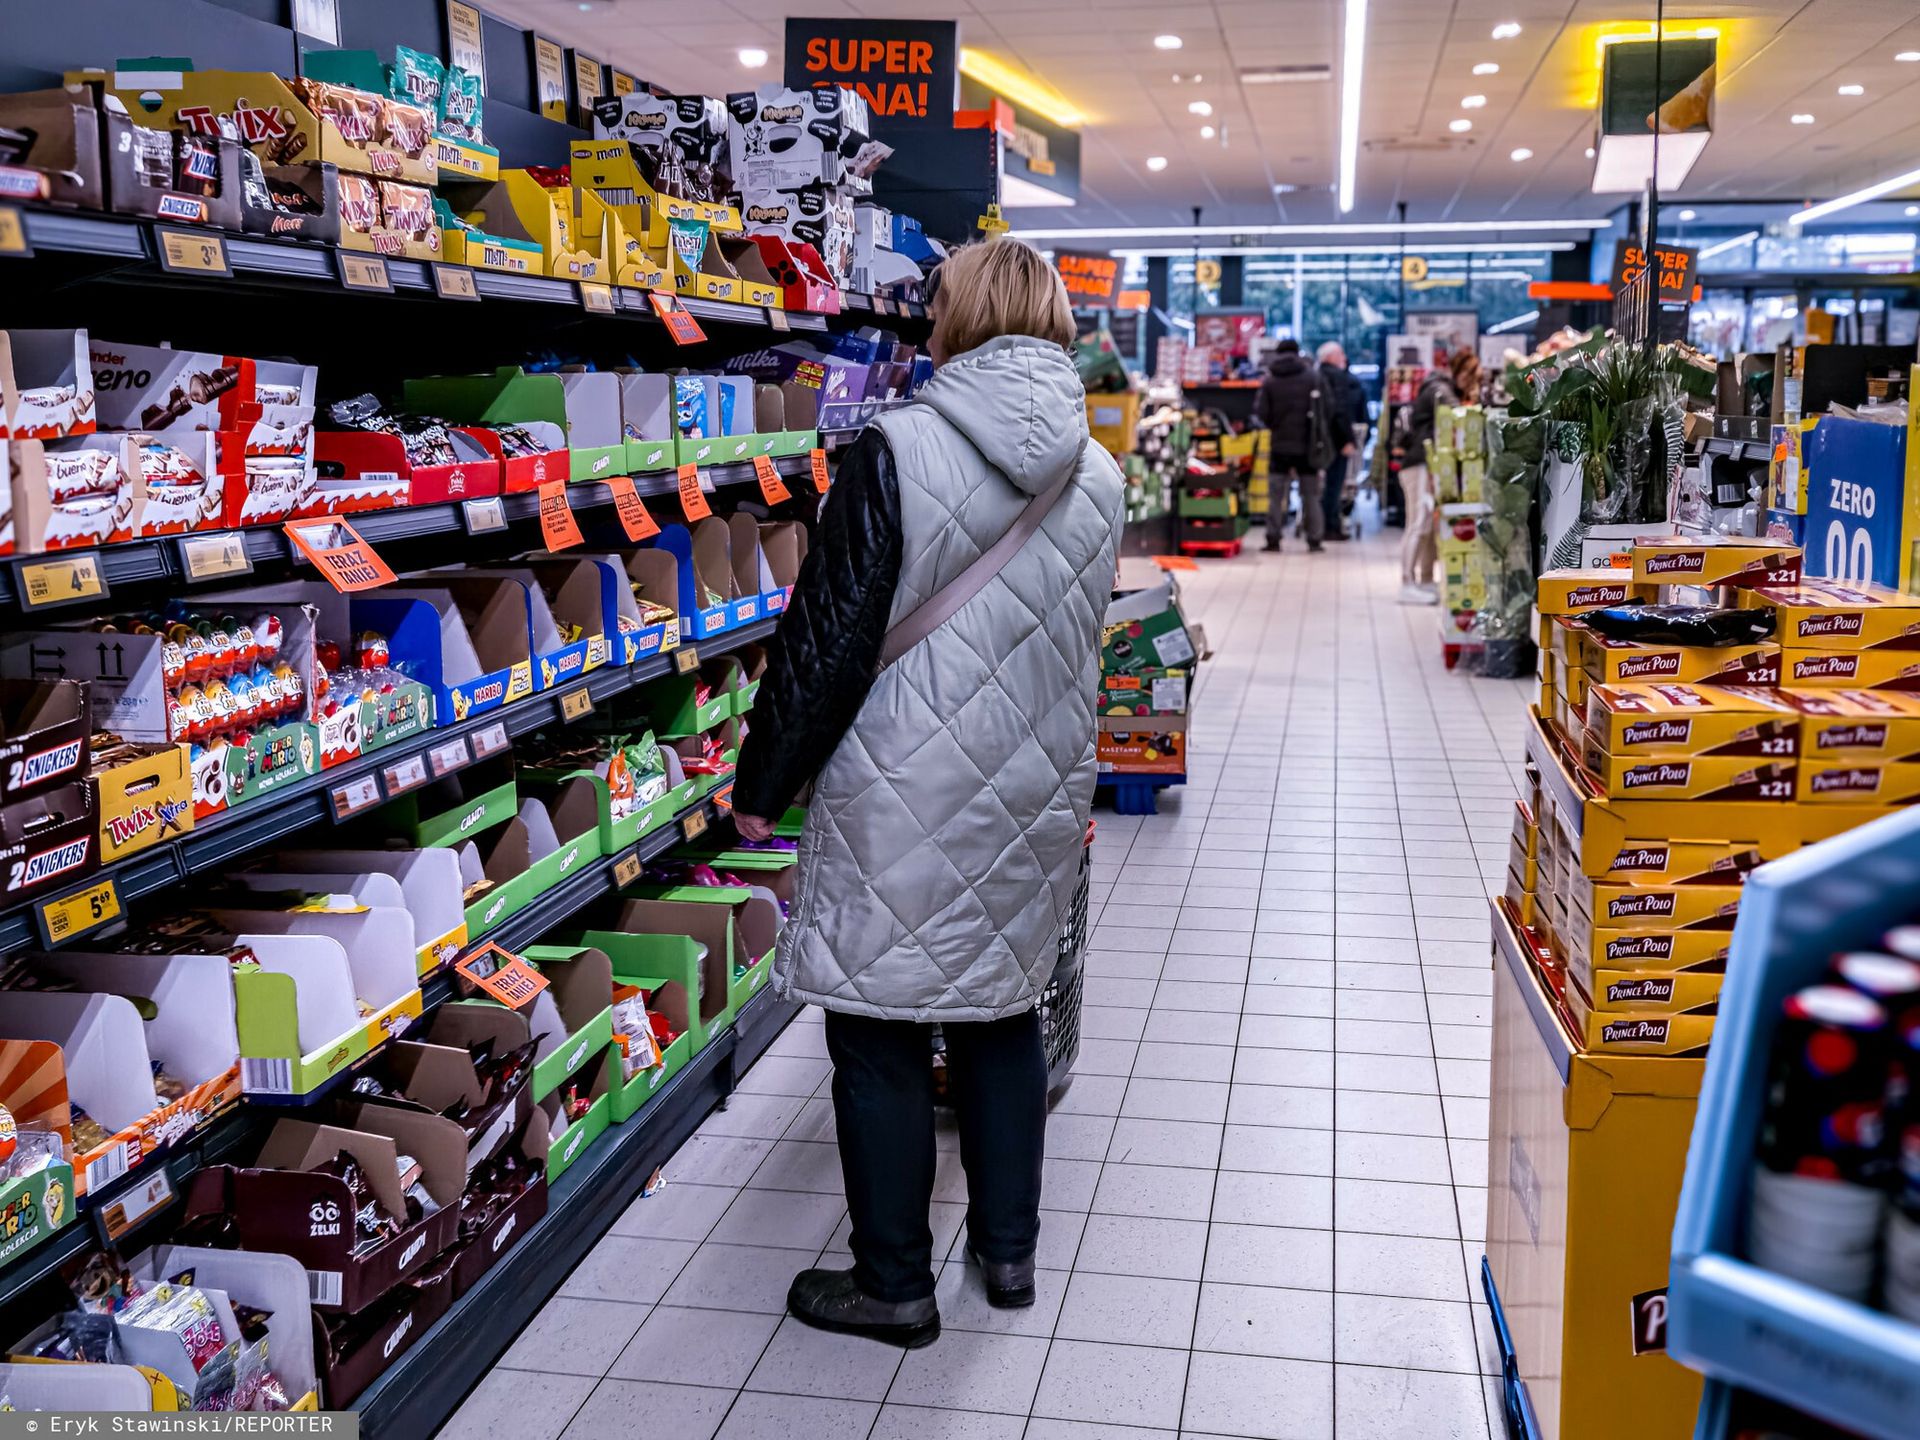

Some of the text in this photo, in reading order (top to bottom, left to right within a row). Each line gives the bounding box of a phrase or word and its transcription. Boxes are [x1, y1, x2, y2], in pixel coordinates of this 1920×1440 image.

[806, 38, 933, 75] SUPER
[812, 81, 929, 118] NA!
[162, 197, 200, 218] SNICKERS
[271, 215, 304, 233] Mars
[727, 349, 781, 369] Milka
[93, 368, 152, 393] eno
[56, 463, 87, 481] bueno
[261, 481, 284, 494] bueno
[1829, 478, 1876, 519] ZERO
[324, 549, 369, 572] TERAZ
[1647, 554, 1702, 572] PRINCE POLO
[337, 565, 379, 586] TANIEJ
[1767, 569, 1797, 583] x21
[32, 588, 48, 597] CENY
[1568, 587, 1623, 606] PRINCE POLO
[705, 611, 726, 632] HARIBO
[1799, 616, 1859, 636] PRINCE POLO
[639, 633, 660, 651] HARIBO
[557, 651, 582, 673] HARIBO
[1619, 656, 1678, 676] PRINCE POLO
[1794, 658, 1855, 678] PRINCE POLO
[1747, 668, 1777, 682] x21
[394, 693, 413, 711] SUPER
[474, 681, 502, 705] HARIBO
[387, 704, 415, 727] MARIO
[1624, 723, 1687, 743] PRINCE POLO
[265, 735, 293, 754] SUPER
[1761, 738, 1794, 753] x21
[7, 743, 80, 792] 2 SNICKERS
[260, 747, 296, 773] MARIO
[1624, 766, 1686, 786] PRINCE POLO
[1760, 781, 1792, 796] x21
[106, 800, 188, 845] Twix Xtra
[7, 841, 87, 892] 2 SNICKERS
[1638, 849, 1664, 864] POLO
[90, 890, 110, 919] 569
[1610, 894, 1672, 915] PRINCE POLO
[1608, 938, 1670, 958] PRINCE POLO
[495, 967, 523, 993] TERAZ
[506, 977, 537, 1002] TANIEJ
[1608, 981, 1671, 1000] PRINCE POLO
[1604, 1022, 1666, 1042] PRINCE POLO
[0, 1191, 31, 1222] UPER
[0, 1203, 38, 1240] RIO
[310, 1221, 341, 1237] ŻELKI
[0, 1226, 39, 1260] KOLEKCJA
[492, 1213, 517, 1254] CANDY
[398, 1231, 427, 1271] CANDY
[383, 1312, 413, 1359] CANDY
